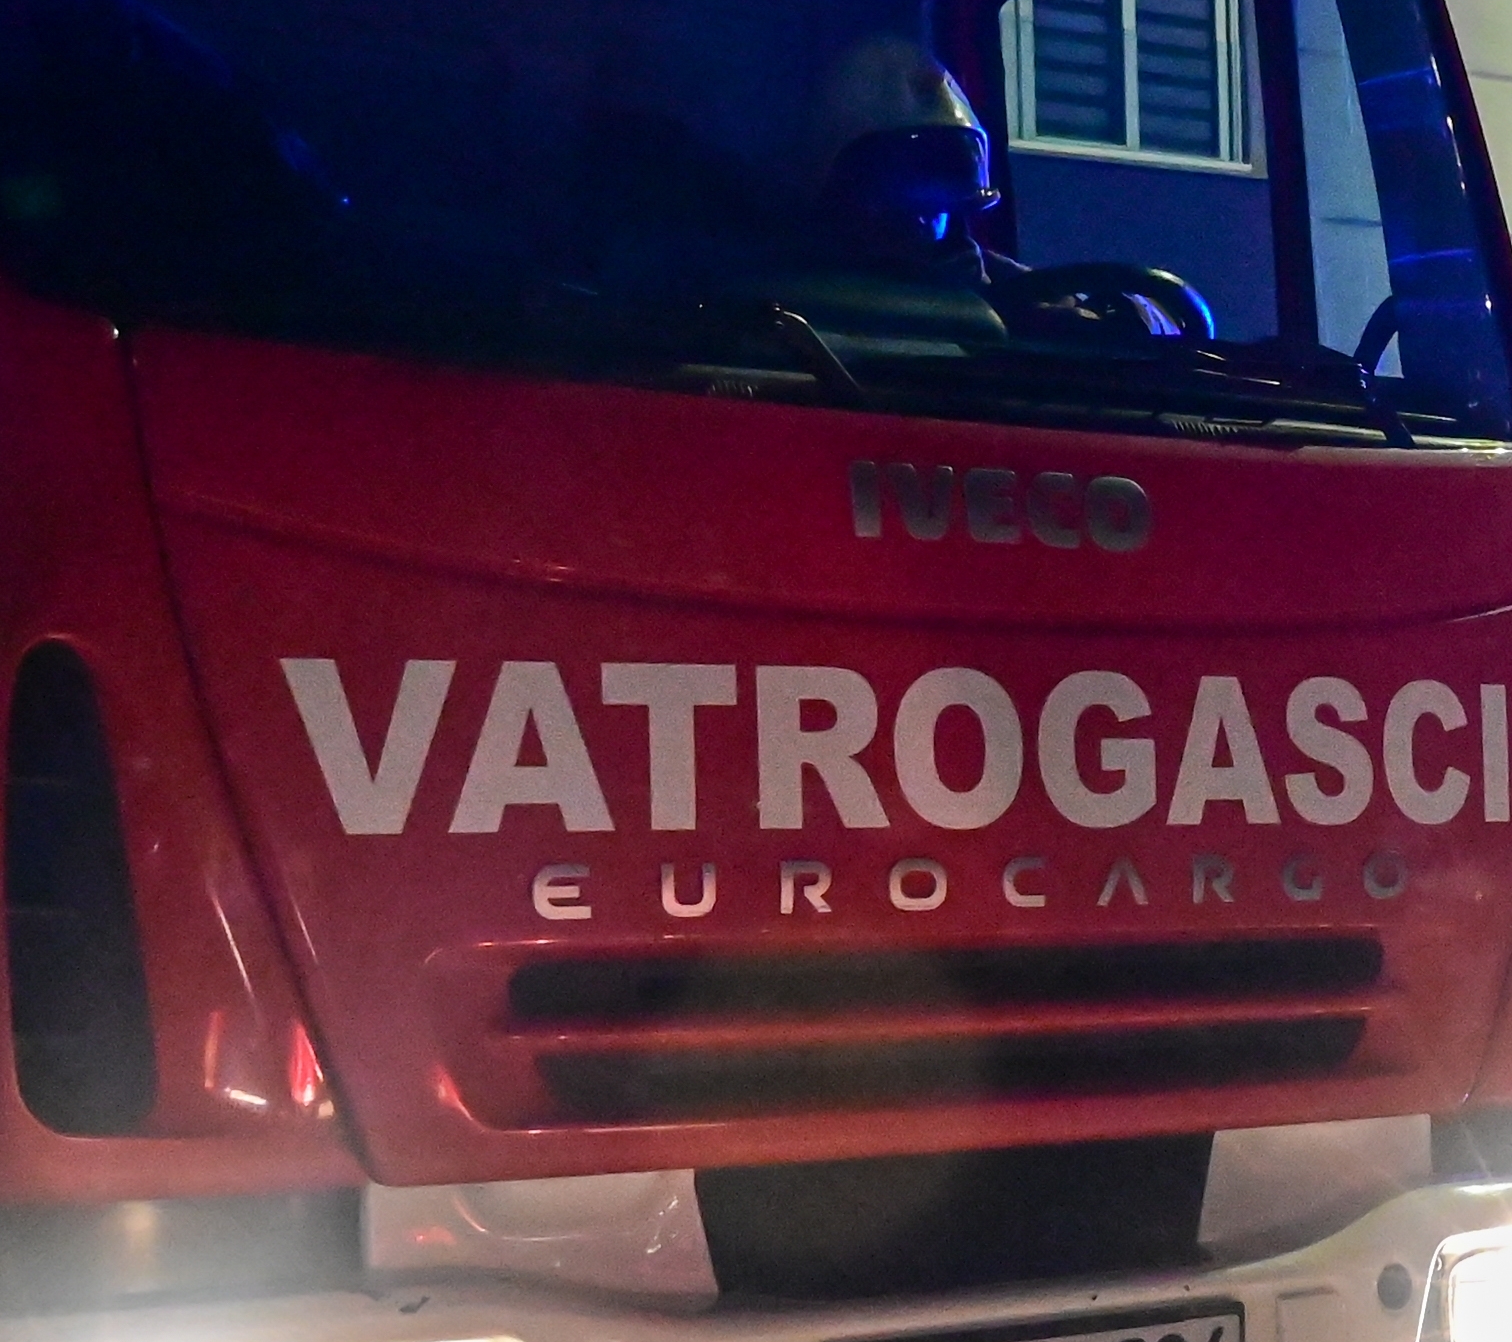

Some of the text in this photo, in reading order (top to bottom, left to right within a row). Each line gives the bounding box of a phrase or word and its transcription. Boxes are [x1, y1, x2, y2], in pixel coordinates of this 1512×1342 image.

[849, 460, 1152, 553] IVECO
[281, 659, 1510, 836] VATROGASCI
[532, 858, 1410, 921] EUROCARGO
